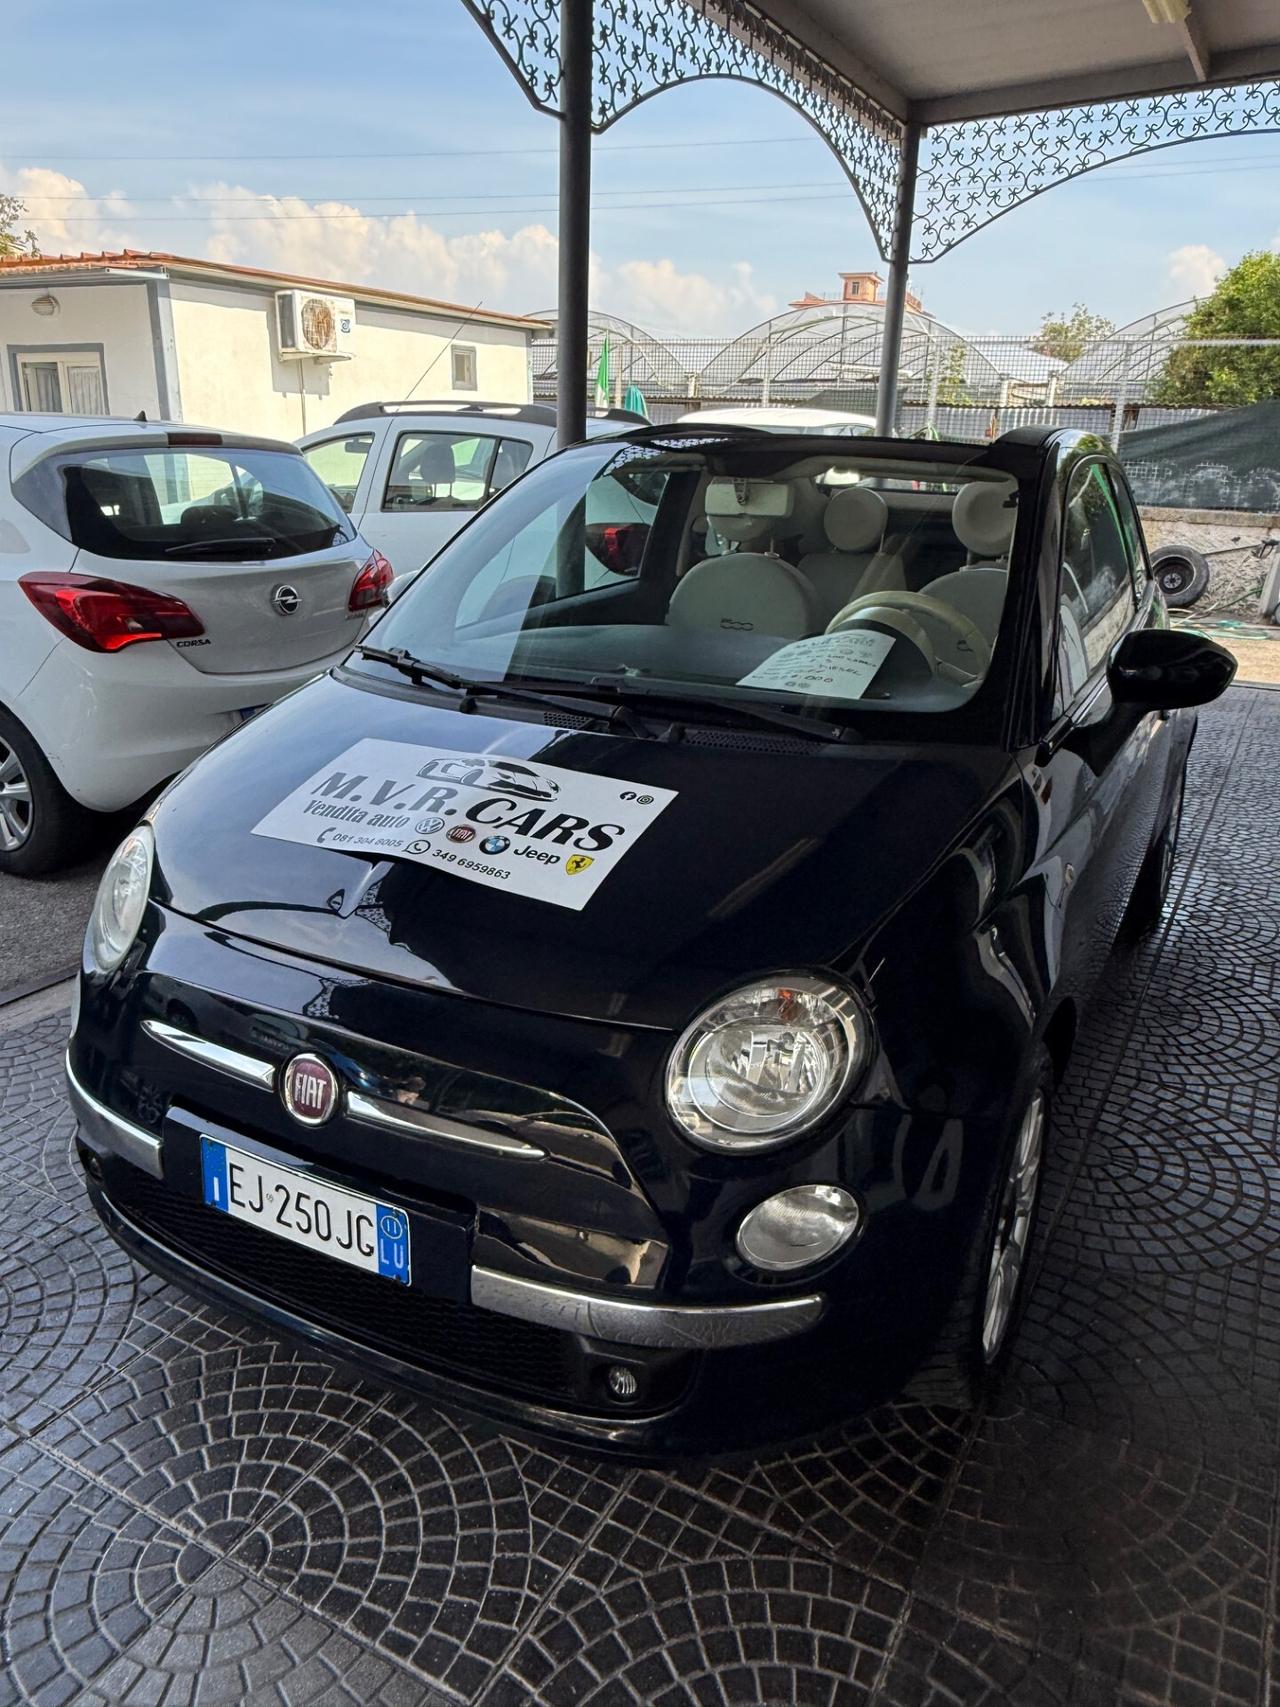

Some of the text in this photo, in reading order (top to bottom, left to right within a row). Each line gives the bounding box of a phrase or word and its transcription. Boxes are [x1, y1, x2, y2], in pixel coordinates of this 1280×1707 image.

[176, 638, 212, 649] CORSA
[303, 799, 411, 829] Vendita auto
[310, 771, 625, 853] M.V.R. CARS
[332, 832, 352, 843] 081
[431, 849, 512, 880] 349 6959863
[513, 845, 561, 865] Jeep
[294, 1072, 328, 1111] FIAT
[379, 1237, 405, 1269] LU
